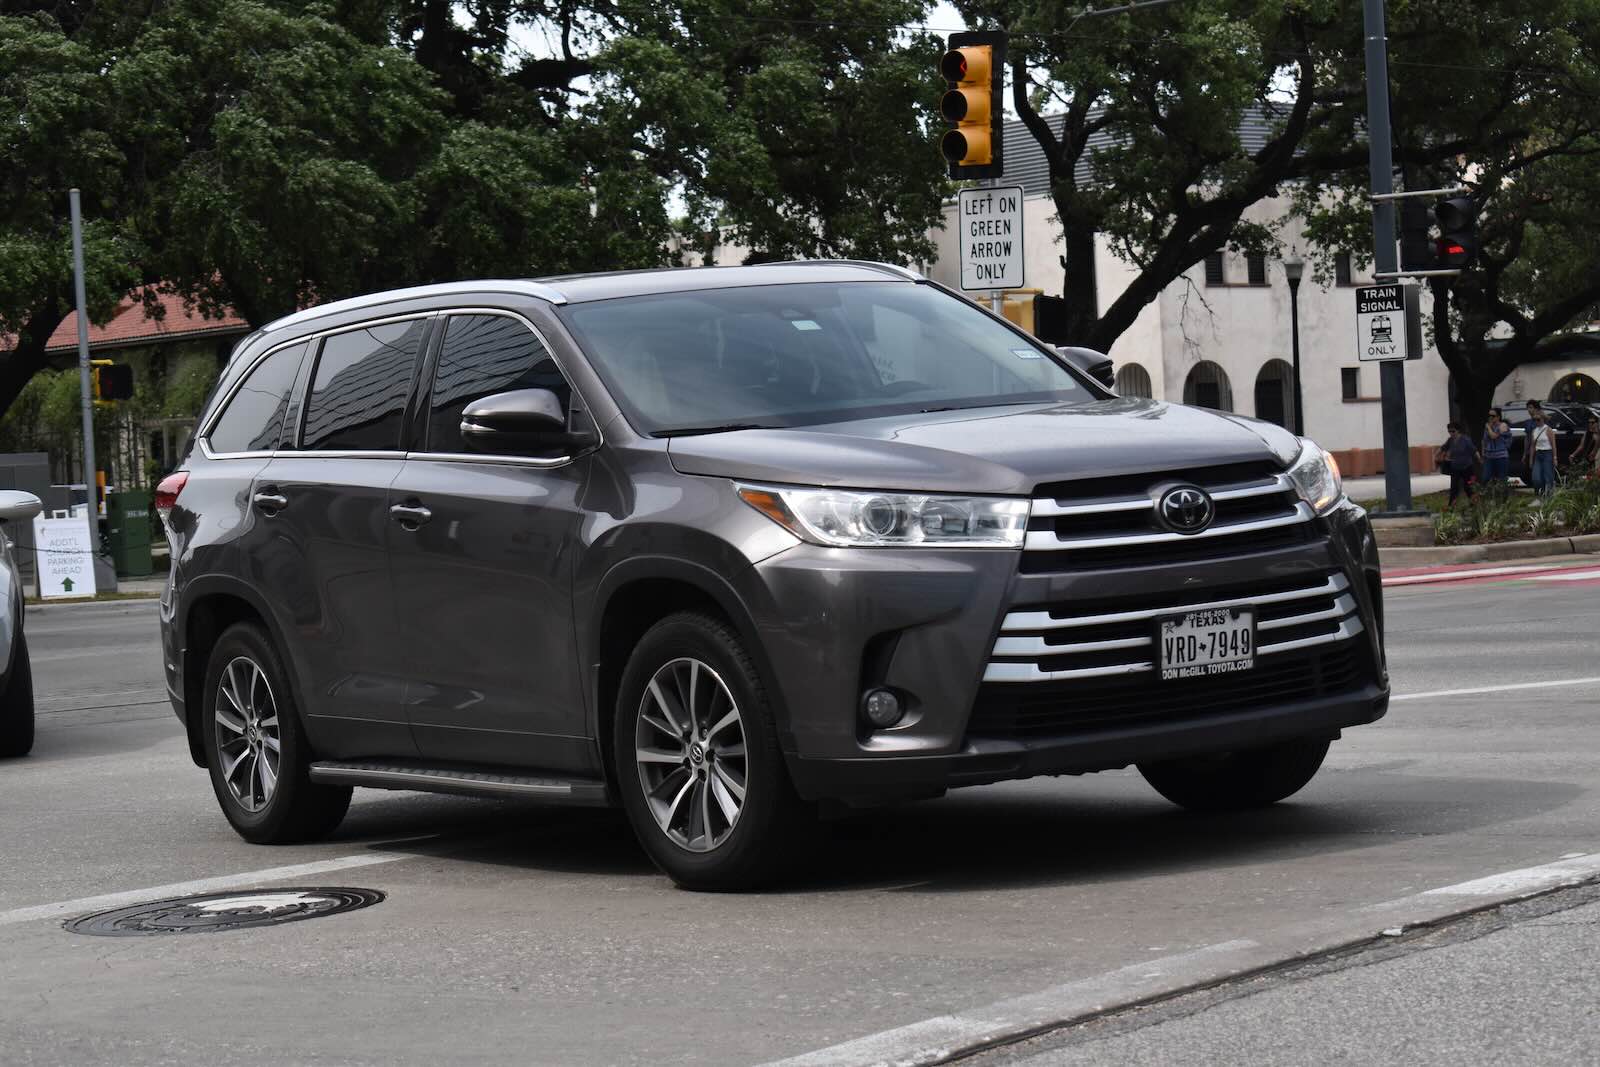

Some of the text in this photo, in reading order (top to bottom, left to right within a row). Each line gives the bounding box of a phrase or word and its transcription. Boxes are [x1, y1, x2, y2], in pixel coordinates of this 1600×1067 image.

[966, 197, 1016, 215] LEFT ON
[970, 219, 1011, 237] GREEN
[970, 241, 1012, 258] ARROW
[976, 263, 1006, 280] ONLY
[1363, 287, 1396, 299] TRAIN
[1360, 300, 1400, 312] SIGNAL
[1368, 345, 1396, 355] ONLY
[47, 556, 84, 566] PARKING
[51, 566, 82, 575] AHEAD
[1190, 615, 1226, 628] TEXAS
[1162, 669, 1178, 680] DON
[1208, 659, 1254, 674] TOYOTA.COM
